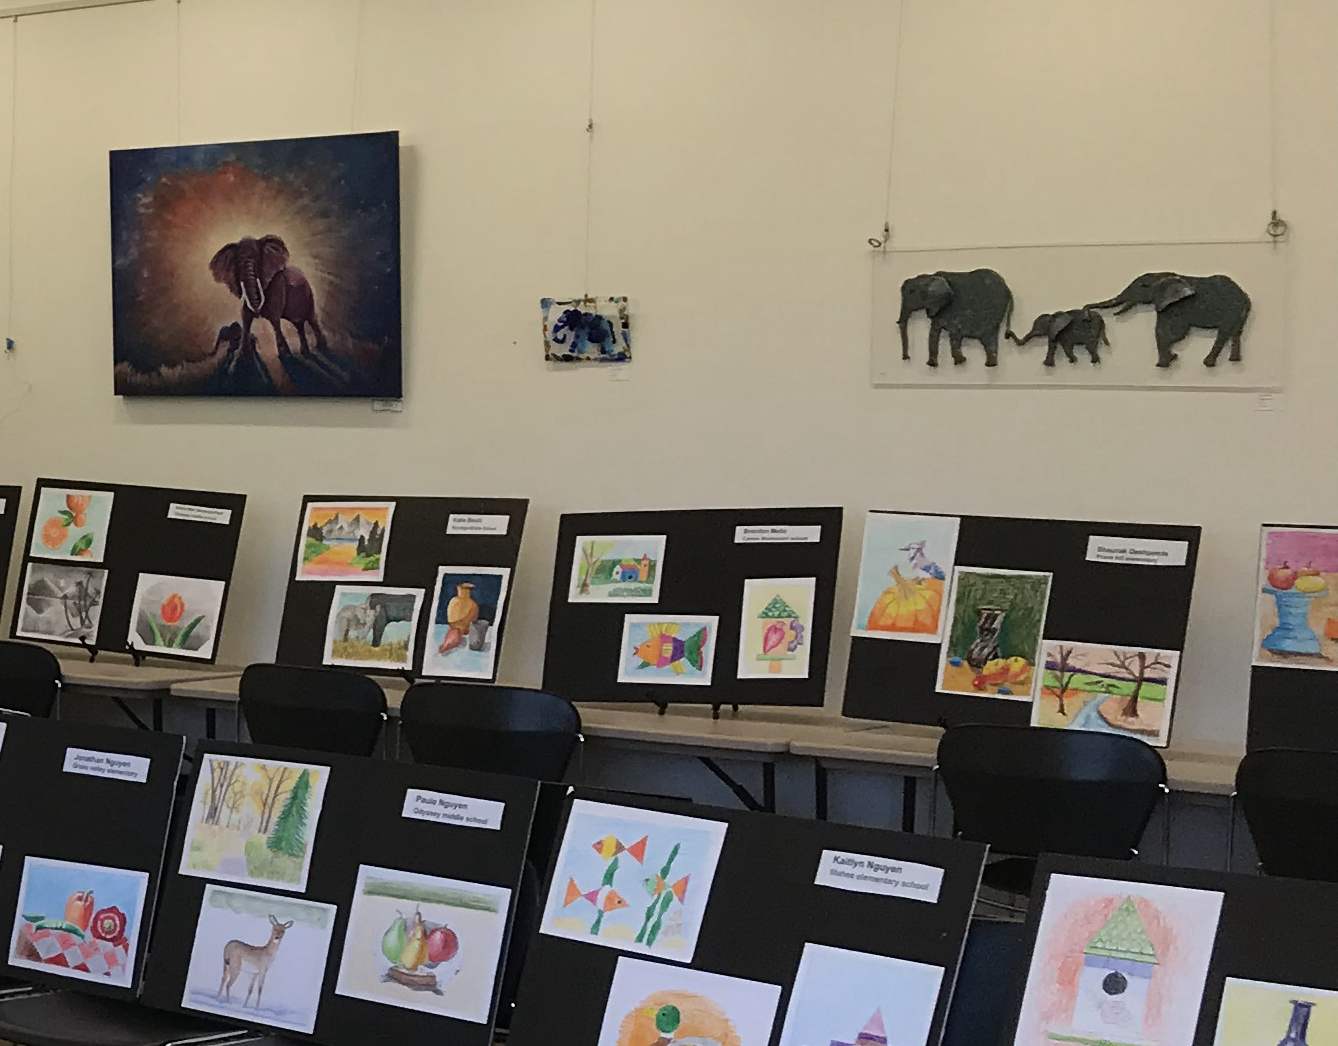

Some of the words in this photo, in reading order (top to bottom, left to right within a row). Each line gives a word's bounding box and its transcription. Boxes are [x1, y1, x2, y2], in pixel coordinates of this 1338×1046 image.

[75, 755, 104, 764] Jonathan
[105, 758, 131, 768] Nguyen
[438, 799, 468, 810] Nguyen
[466, 816, 489, 825] school
[833, 856, 865, 869] Kaitlyn
[867, 860, 903, 874] Nguyen
[856, 874, 900, 888] elementary
[901, 881, 930, 891] school
